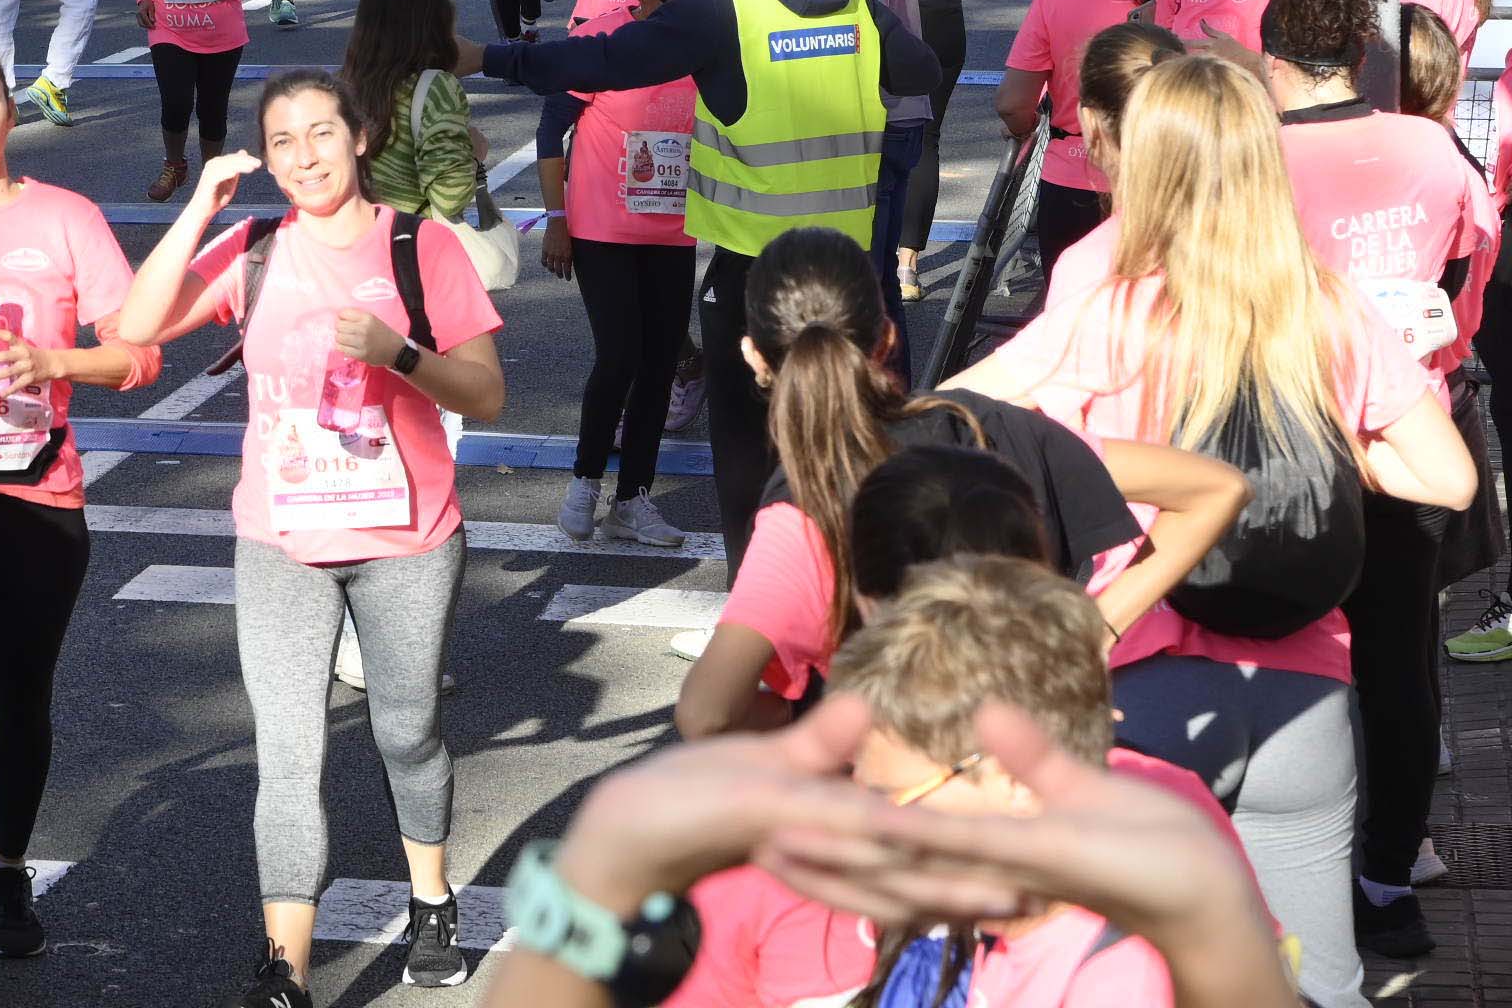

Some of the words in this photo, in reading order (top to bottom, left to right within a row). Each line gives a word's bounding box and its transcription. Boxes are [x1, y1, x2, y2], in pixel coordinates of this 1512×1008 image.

[167, 13, 214, 27] SUMA
[770, 33, 856, 54] VOLUNTARIS
[657, 164, 682, 176] 016
[1331, 203, 1430, 240] CARRERA
[1351, 231, 1382, 258] DE
[1387, 229, 1413, 252] LA
[315, 456, 360, 474] 016
